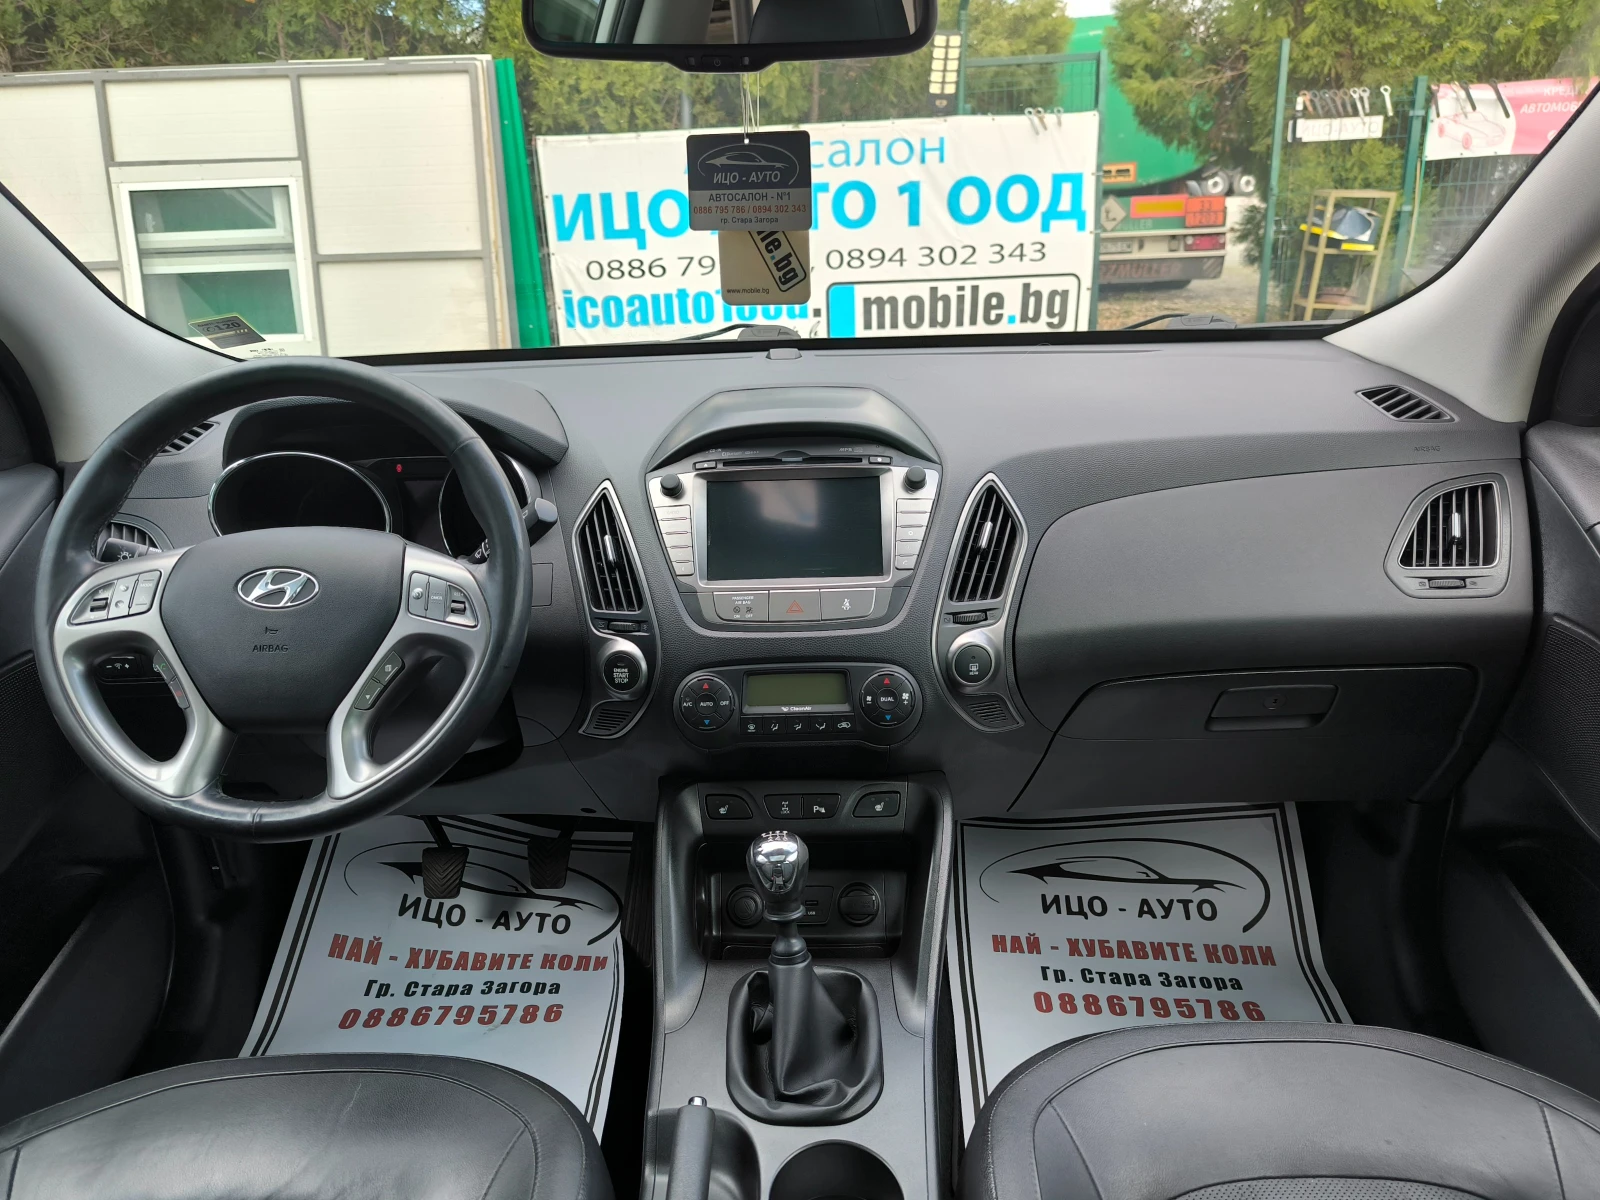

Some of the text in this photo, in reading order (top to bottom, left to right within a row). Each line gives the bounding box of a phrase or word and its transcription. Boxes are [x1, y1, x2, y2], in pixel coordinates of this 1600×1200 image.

[1520, 101, 1582, 114] АВТОМОБ
[713, 172, 739, 185] ИЦО
[749, 171, 780, 183] АУТО
[694, 206, 712, 214] 0886
[715, 206, 729, 214] 795
[731, 206, 745, 214] 786
[752, 205, 772, 213] 0894
[774, 205, 789, 213] 302
[791, 204, 807, 213] 343
[709, 192, 768, 202] АВТОСАЛОН
[552, 189, 690, 250] ИЦО
[897, 180, 920, 227] 1
[947, 173, 1087, 233] ООД
[731, 217, 753, 225] Стара
[586, 242, 1046, 281] 0886 79 0894 302 343
[727, 287, 770, 295] www.mobile.bg
[862, 282, 1070, 330] mobile.bg
[252, 644, 288, 653] AIRBAG
[398, 893, 466, 929] ИЦО
[492, 910, 571, 935] АУТО
[1041, 893, 1108, 920] ИЦО
[1137, 898, 1218, 921] АУТО
[328, 933, 383, 966] НАЙ
[405, 947, 534, 971] ХУБАВИТЕ
[540, 953, 608, 972] КОЛИ
[991, 932, 1042, 955] НАЙ
[1066, 937, 1198, 963] ХУБАВИТЕ
[1202, 943, 1277, 967] КОЛИ
[364, 979, 561, 999] Гр. Стара Загора
[1041, 965, 1244, 991] Гр. Стара Загора
[338, 1003, 564, 1030] 0886795786
[1033, 991, 1266, 1022] 0886795786
